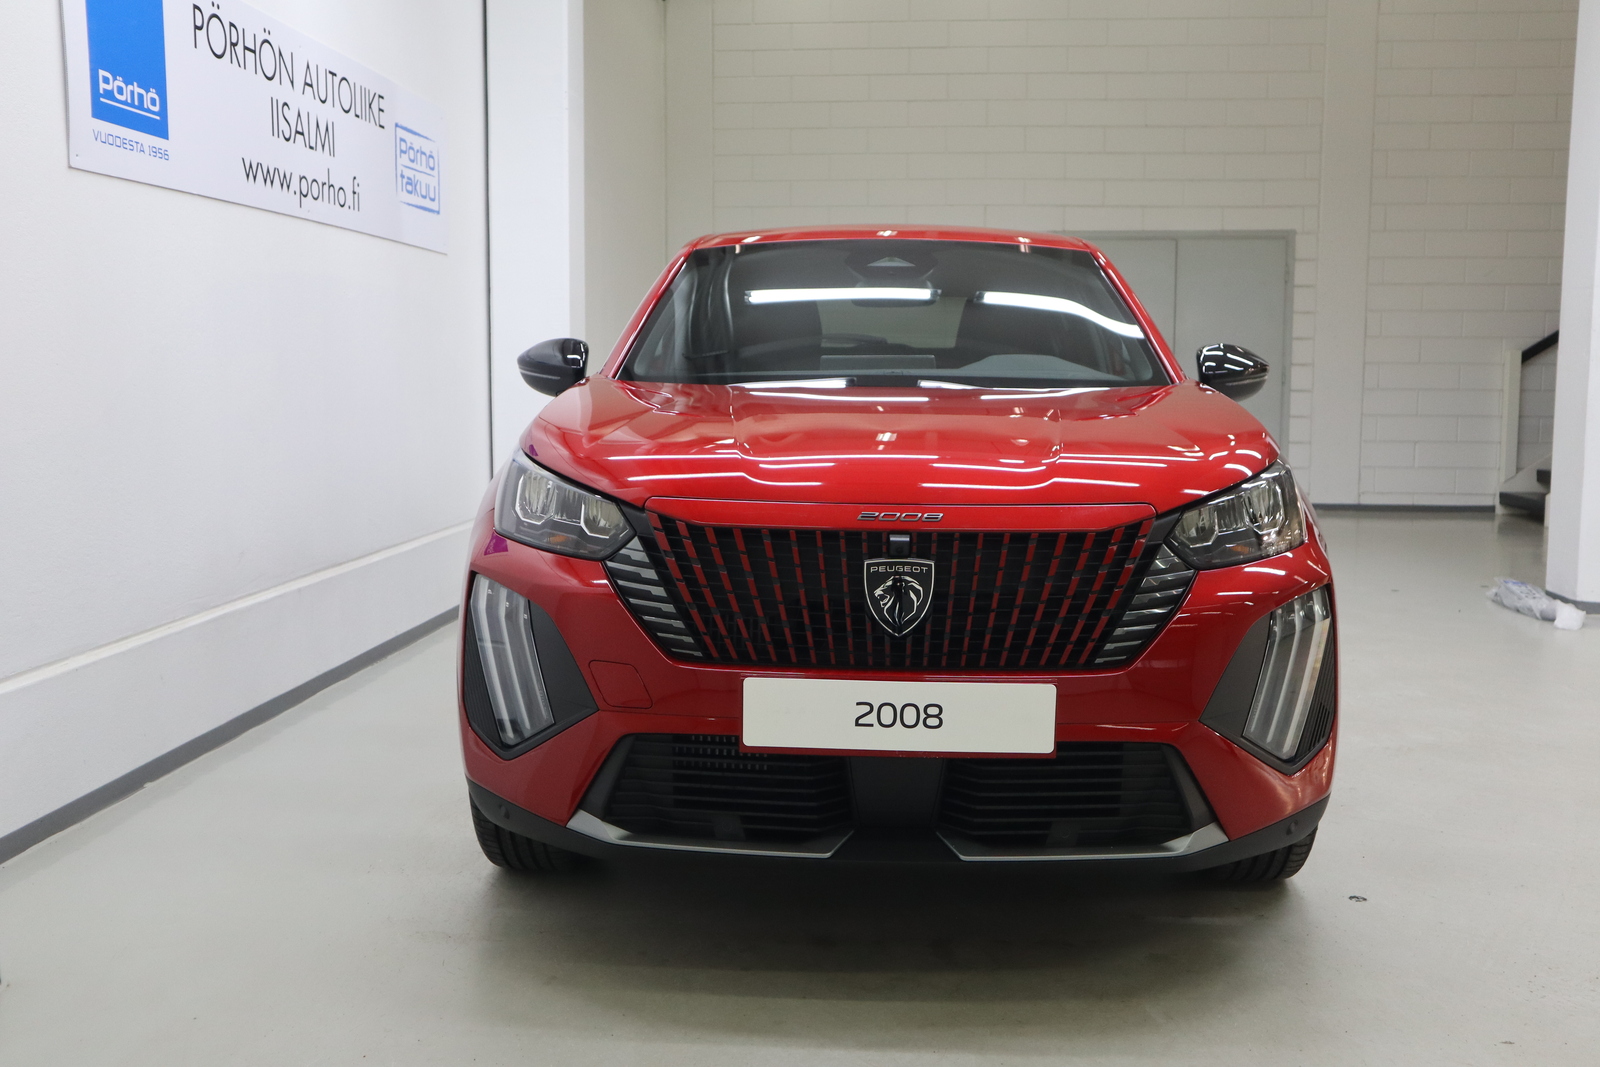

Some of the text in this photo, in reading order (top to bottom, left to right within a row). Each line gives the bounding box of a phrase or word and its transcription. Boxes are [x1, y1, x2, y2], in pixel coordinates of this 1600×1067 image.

[192, 1, 385, 129] PÖRHÖN AUTOLIIKE
[98, 69, 160, 113] Pörhö
[270, 97, 336, 158] IISALMI
[92, 128, 170, 161] VUODESTA 1956
[241, 157, 361, 212] www.porho.fi
[400, 172, 437, 203] takuu
[857, 511, 944, 522] 2008
[870, 565, 928, 574] PEUGEOT
[854, 701, 944, 730] 2008
